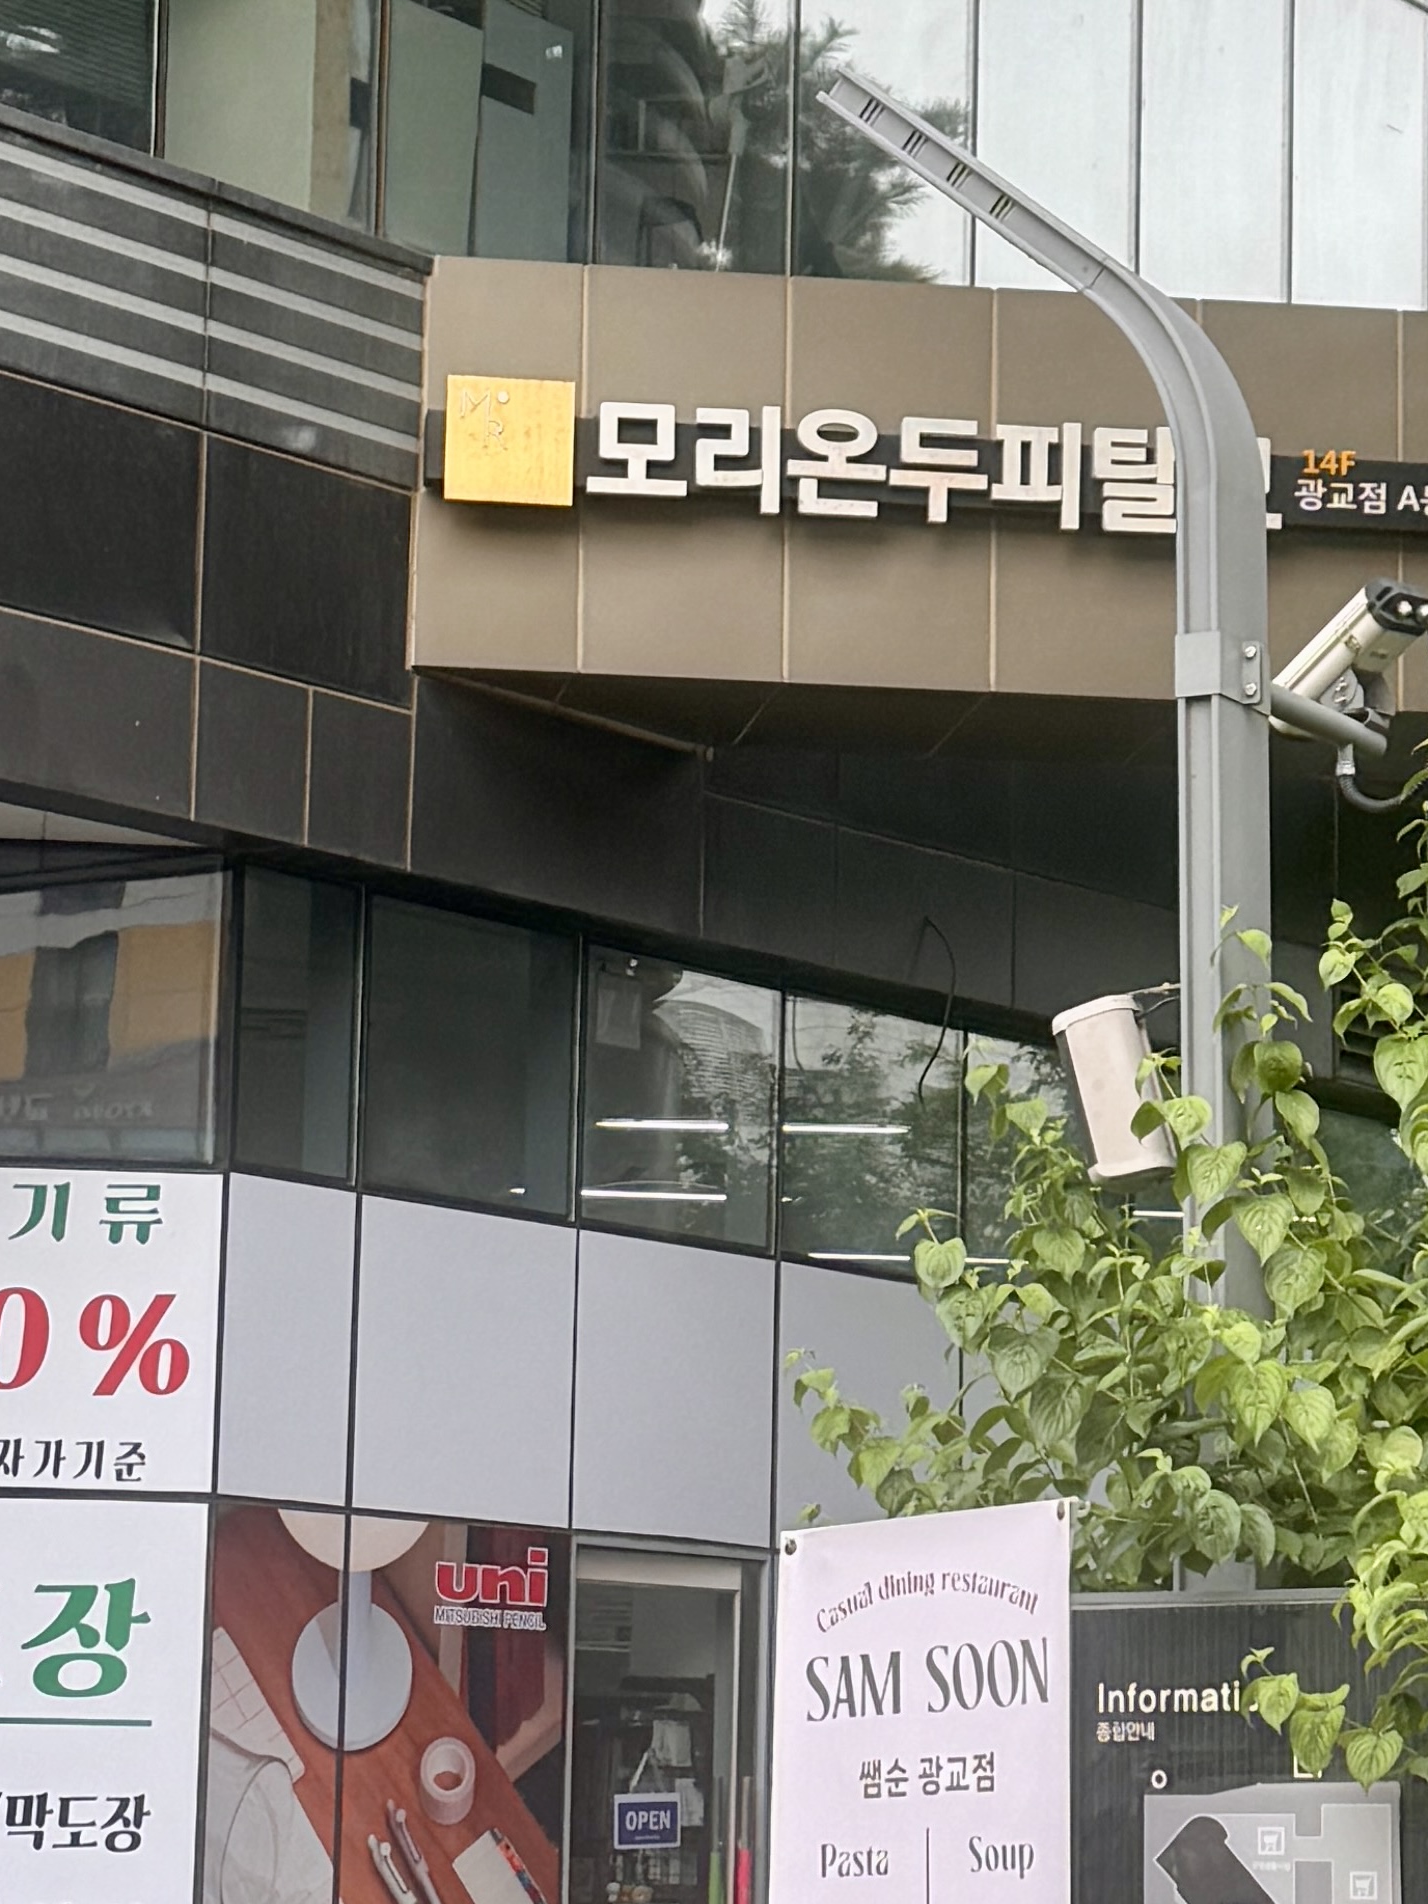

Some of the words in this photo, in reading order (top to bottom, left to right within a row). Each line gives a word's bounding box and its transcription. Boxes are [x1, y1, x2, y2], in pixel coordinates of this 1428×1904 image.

[586, 400, 1281, 533] 모리온두피탈
[1302, 449, 1356, 476] 14F
[1294, 478, 1387, 514] 광교점
[435, 1547, 549, 1608] uni
[879, 1571, 935, 1601] dining
[941, 1570, 1039, 1616] restaurant
[434, 1605, 500, 1627] MITSUBISHI
[504, 1610, 546, 1630] PENCIL
[806, 1651, 901, 1722] SAM
[926, 1637, 1049, 1714] SOON
[1098, 1680, 1260, 1714] Informati
[859, 1759, 909, 1799] 쌤순
[918, 1751, 995, 1796] 광교점
[626, 1810, 670, 1830] OPEN
[820, 1843, 889, 1878] Pasta
[968, 1836, 1034, 1879] Soup
